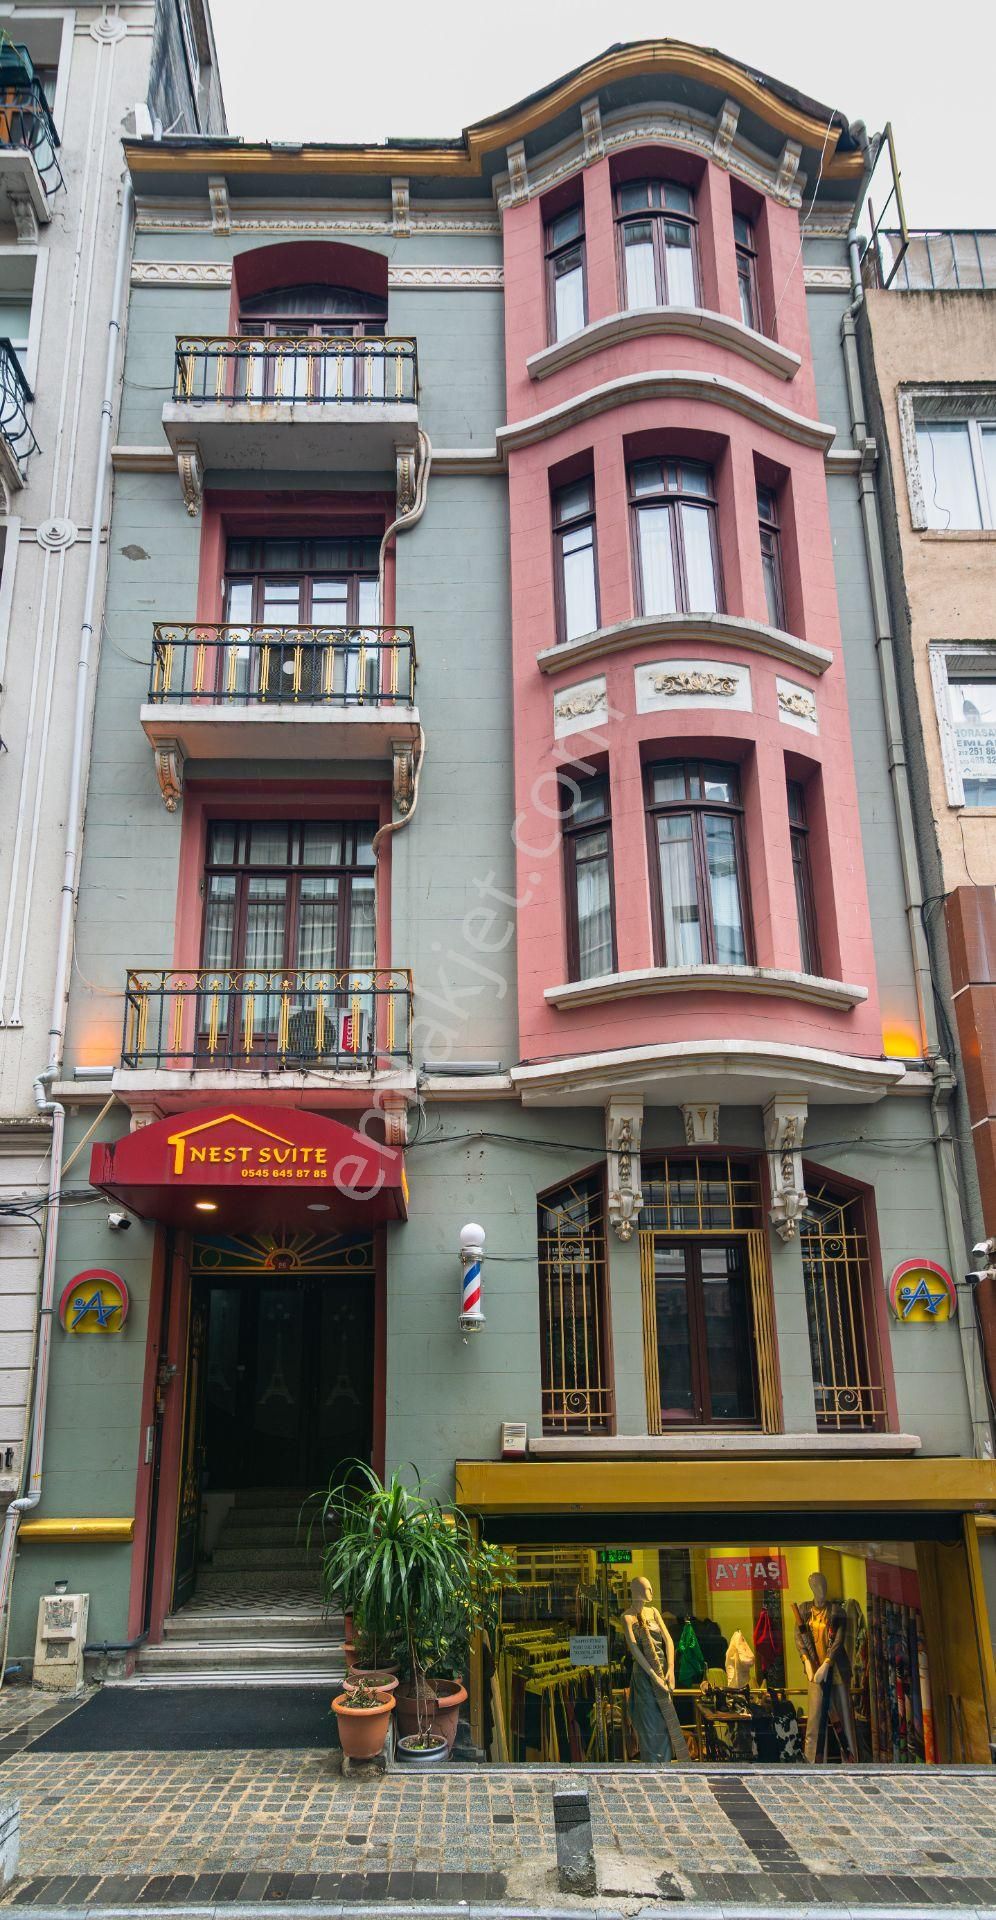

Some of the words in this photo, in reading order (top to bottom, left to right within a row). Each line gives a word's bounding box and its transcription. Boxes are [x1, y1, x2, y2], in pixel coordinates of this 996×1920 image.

[190, 1147, 252, 1163] NEST
[258, 1147, 327, 1163] SUITE
[242, 1169, 269, 1178] 0545
[272, 1169, 293, 1178] 645
[296, 1170, 310, 1178] 87
[313, 1170, 327, 1178] 85
[716, 1562, 780, 1580] AYTAŞ
